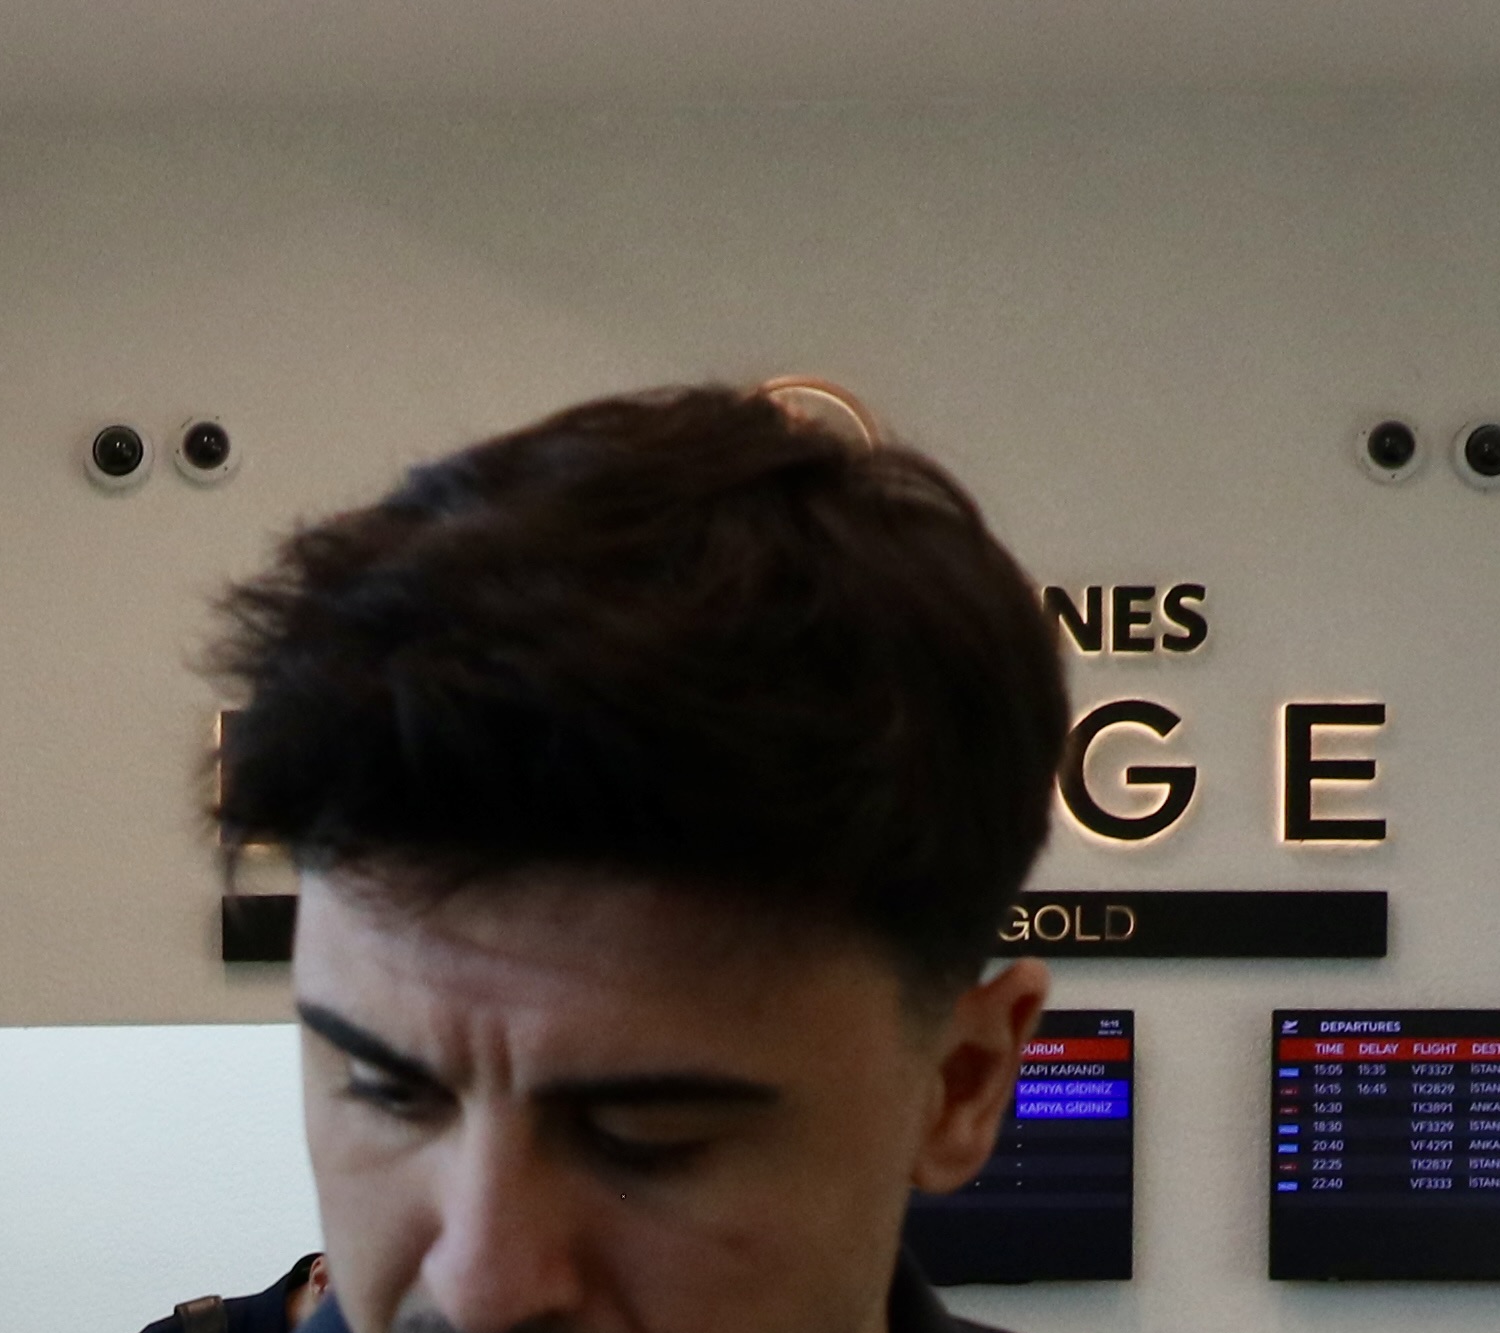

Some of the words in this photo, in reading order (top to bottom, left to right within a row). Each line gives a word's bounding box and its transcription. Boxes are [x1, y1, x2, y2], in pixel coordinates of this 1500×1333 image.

[998, 903, 1137, 942] GOLD
[1320, 1022, 1401, 1032] DEPARTURES
[1314, 1043, 1344, 1055] TIME
[1359, 1043, 1399, 1055] DELAY
[1413, 1043, 1458, 1055] FLIGHT
[1020, 1064, 1048, 1076] KAPI
[1050, 1064, 1105, 1076] KAPANDI
[1020, 1084, 1063, 1095] KAPIYA
[1020, 1103, 1063, 1114] KAPIYA
